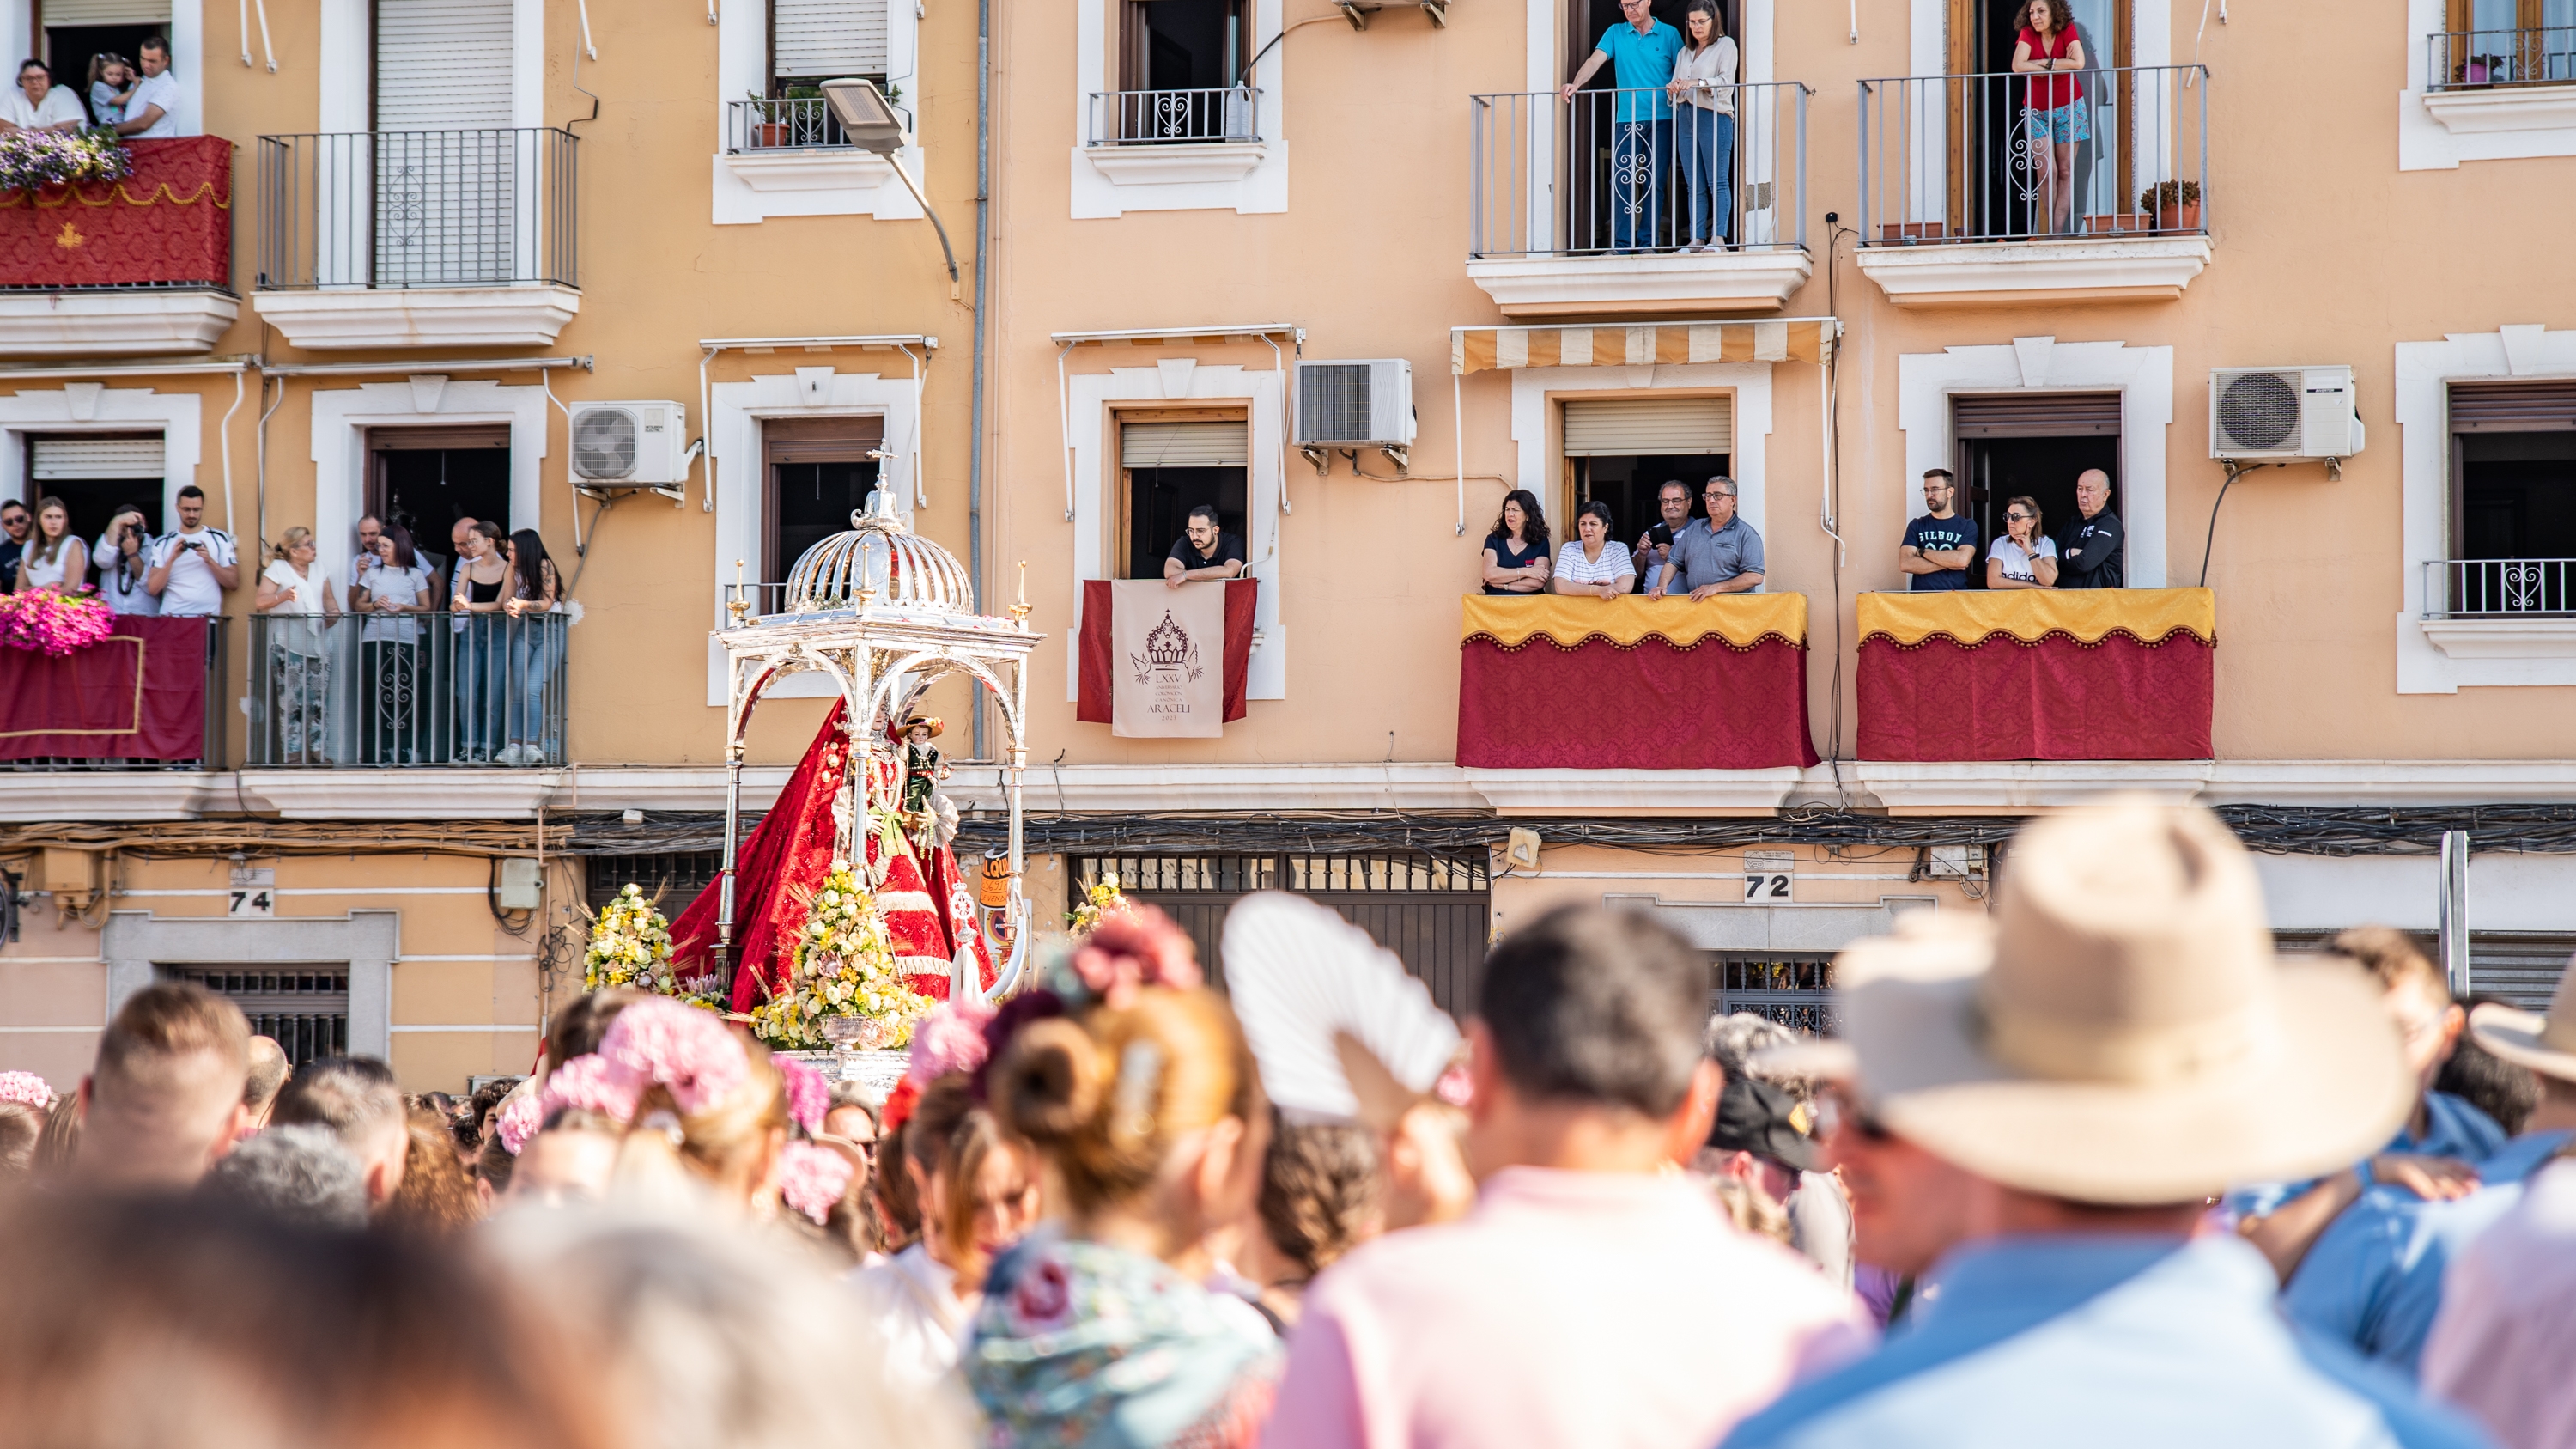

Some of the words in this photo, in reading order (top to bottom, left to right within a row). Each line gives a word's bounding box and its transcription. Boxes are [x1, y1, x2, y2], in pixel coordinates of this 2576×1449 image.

[1156, 673, 1182, 684] LXXV
[1147, 703, 1190, 713] ARACELI
[1747, 875, 1789, 898] 72
[230, 892, 270, 912] 74
